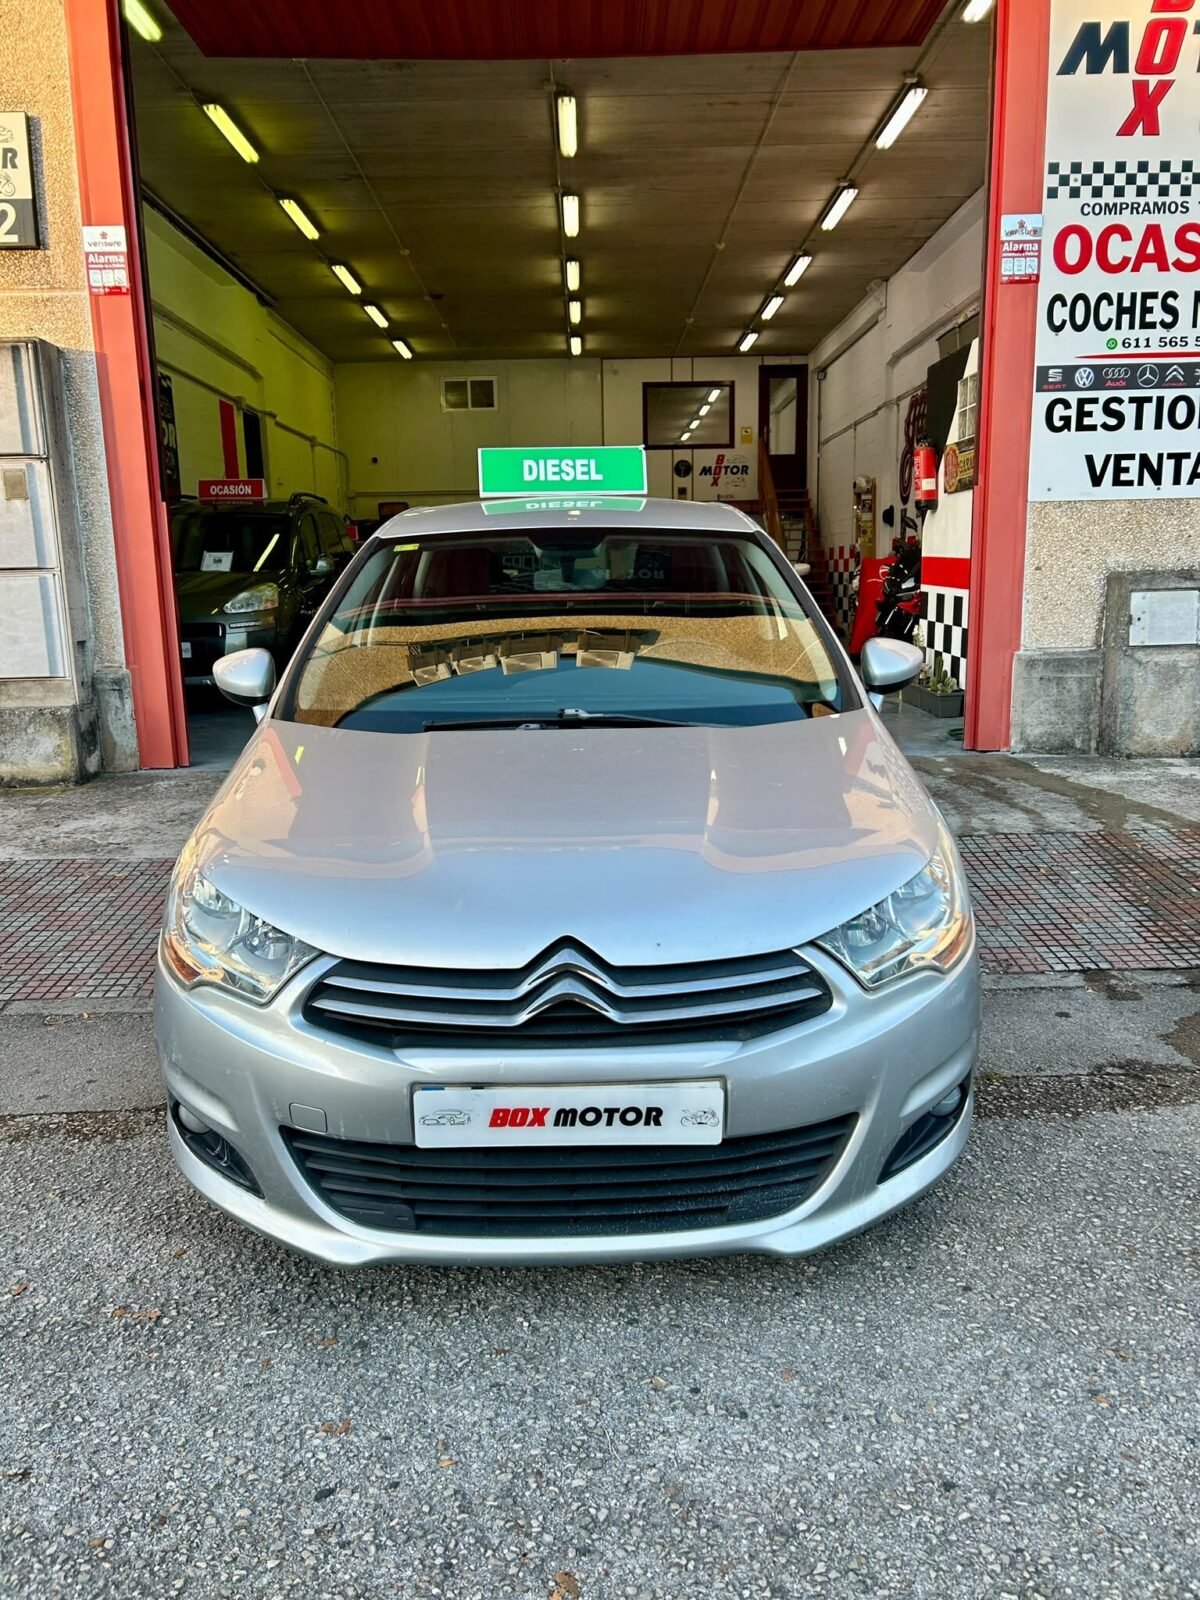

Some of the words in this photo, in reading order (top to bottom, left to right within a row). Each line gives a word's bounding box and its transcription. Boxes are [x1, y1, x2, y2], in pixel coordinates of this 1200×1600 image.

[1080, 200, 1190, 216] COMPRAMOS
[1003, 241, 1038, 251] Alarma
[88, 253, 125, 263] Alarma
[1047, 290, 1179, 333] COCHES
[1122, 337, 1151, 348] 611
[1158, 336, 1188, 348] 565
[1045, 394, 1200, 433] GESTIO
[522, 459, 603, 481] DIESEL
[210, 482, 252, 495] OCASIÓN
[488, 1107, 551, 1128] BOX
[553, 1106, 663, 1127] MOTOR
